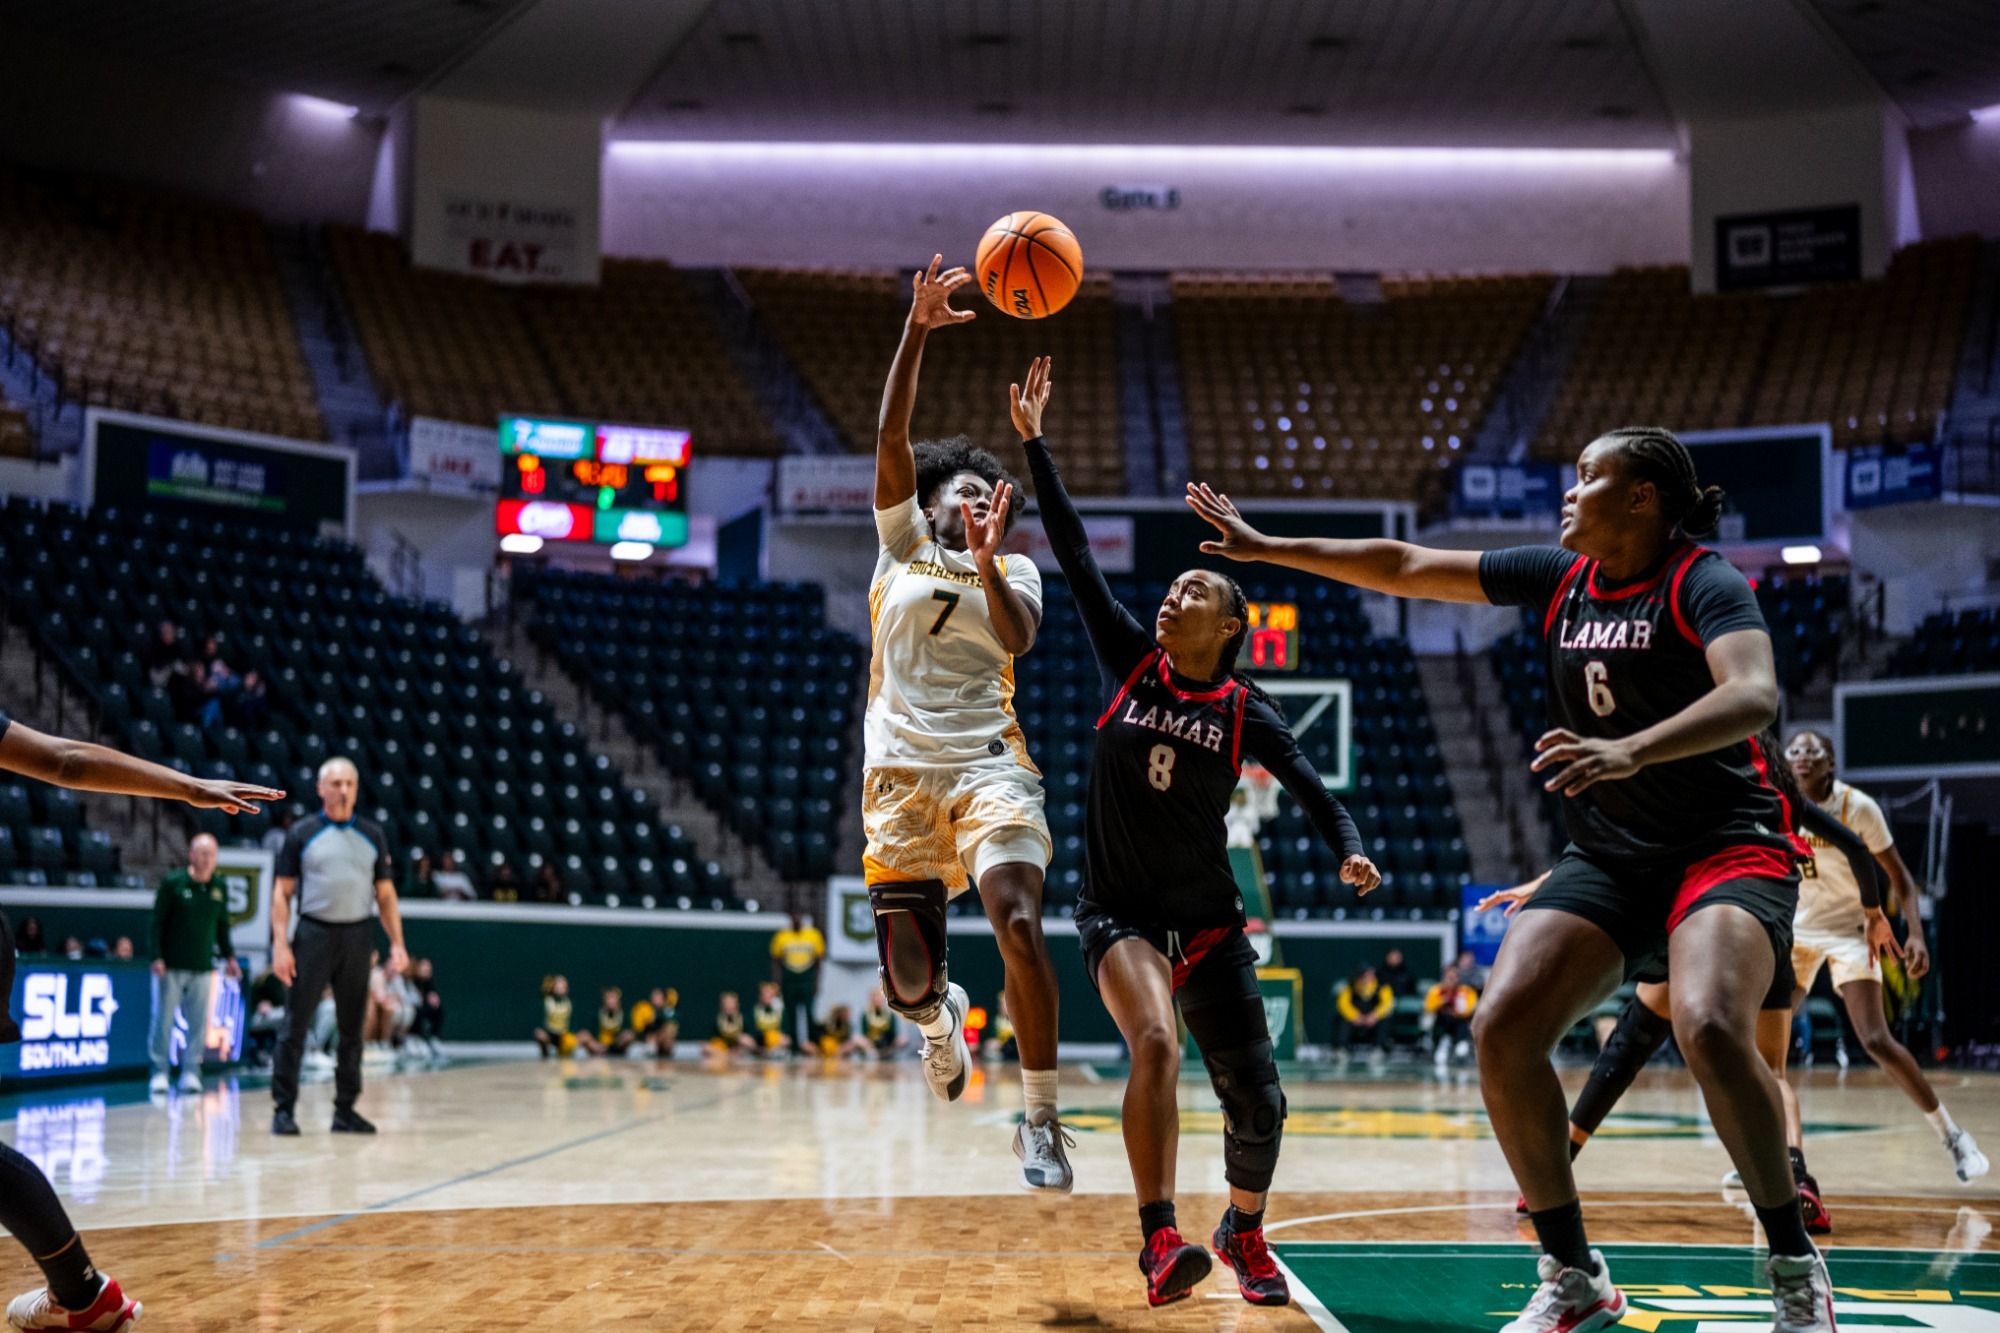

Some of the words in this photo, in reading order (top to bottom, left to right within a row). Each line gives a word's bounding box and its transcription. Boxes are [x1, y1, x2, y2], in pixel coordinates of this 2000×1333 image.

[928, 588, 961, 637] 7
[1560, 618, 1652, 649] LAMAR
[1584, 660, 1617, 718] 6
[1123, 699, 1224, 753] LAMAR
[1148, 743, 1176, 792] 8
[22, 973, 119, 1040] SLC
[20, 1039, 109, 1071] SOUTHLAND
